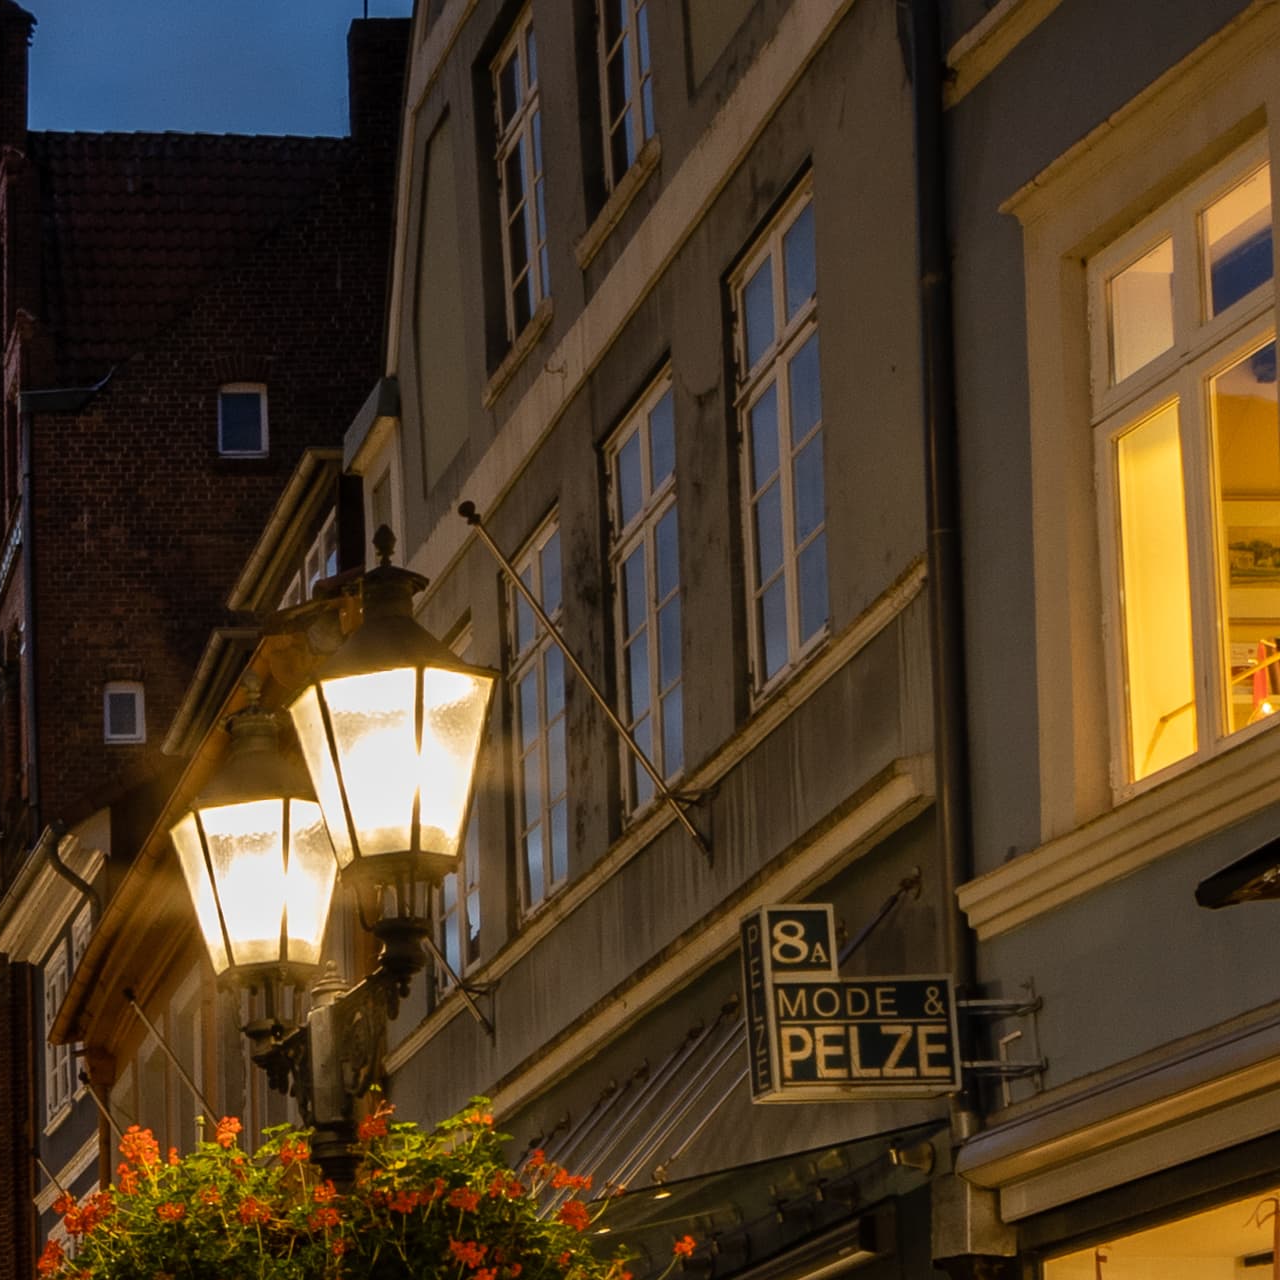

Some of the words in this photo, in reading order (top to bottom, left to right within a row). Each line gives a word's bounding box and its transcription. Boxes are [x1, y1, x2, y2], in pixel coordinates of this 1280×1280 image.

[747, 924, 769, 1090] PELZE
[777, 987, 898, 1018] MODE
[924, 986, 945, 1016] &
[781, 1025, 951, 1080] PELZE
